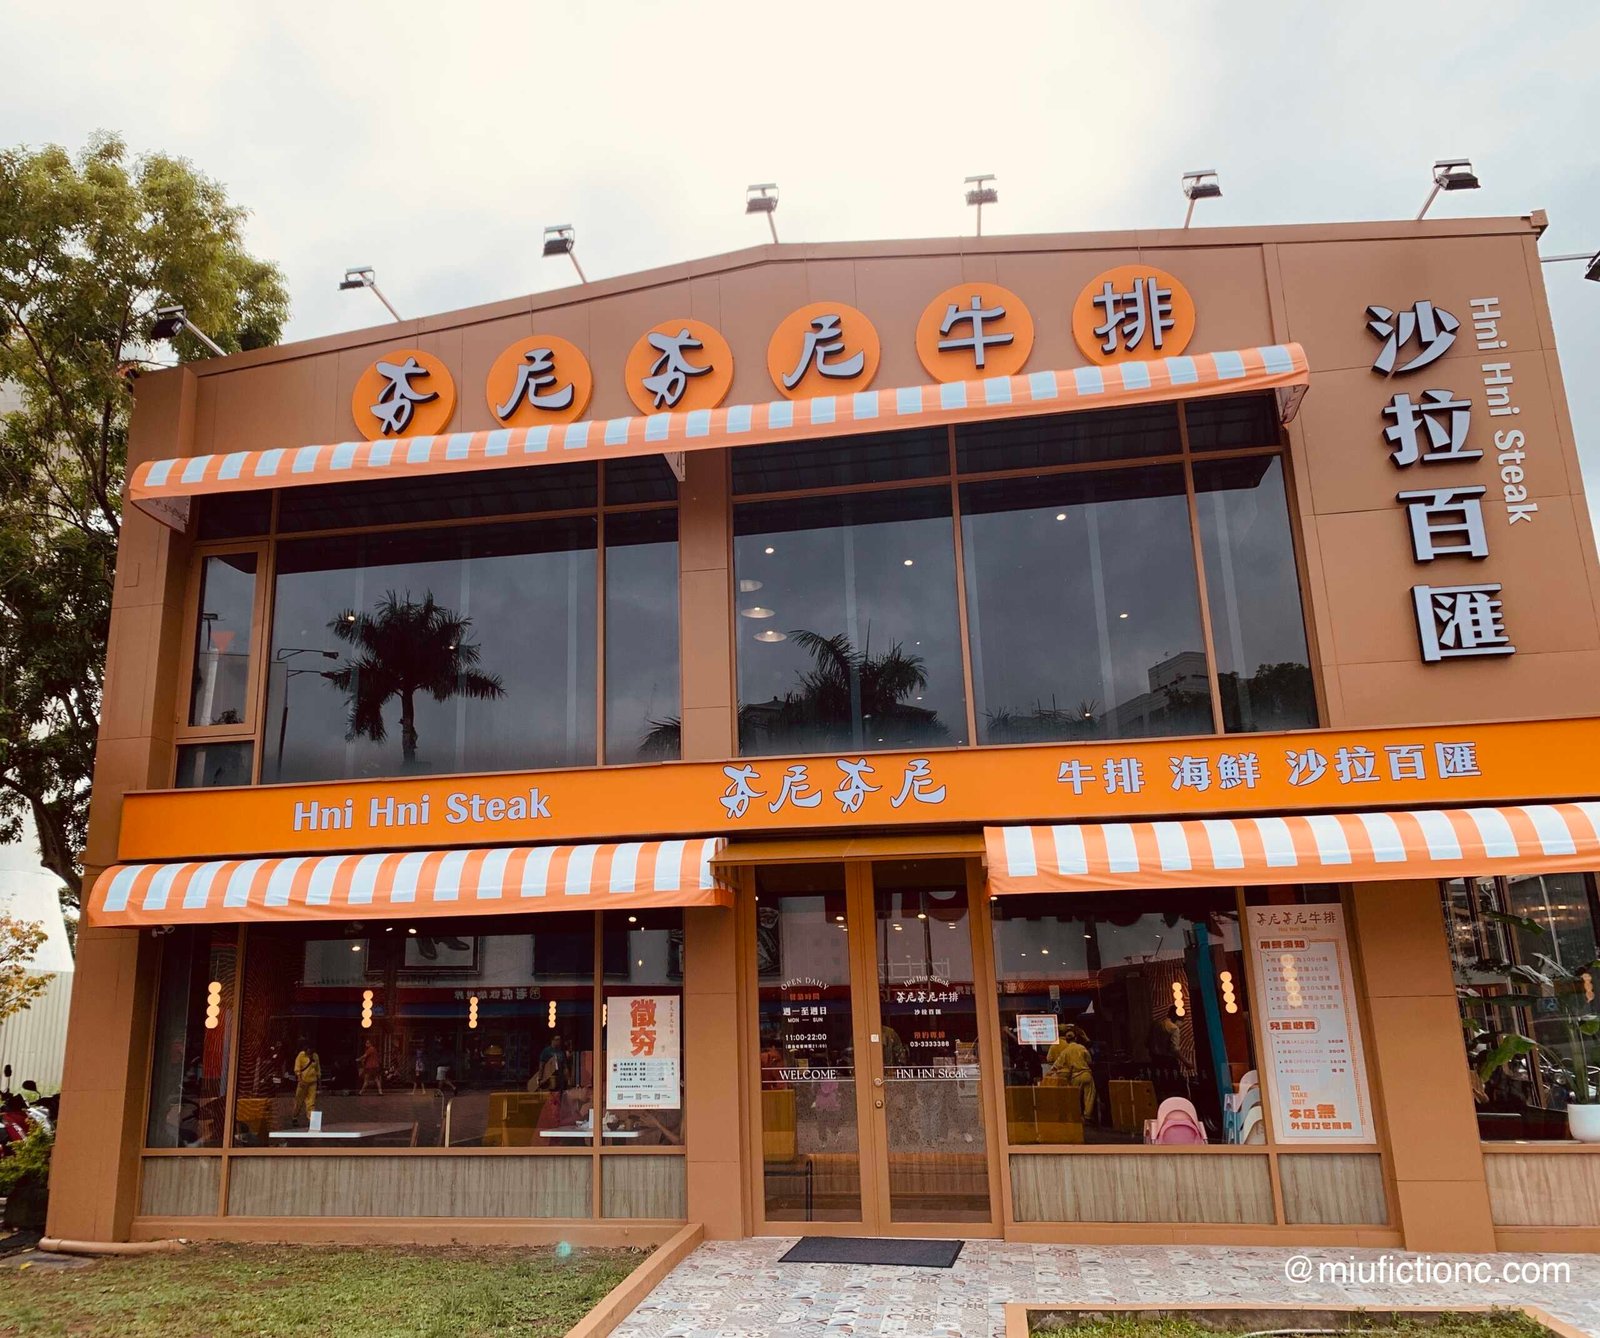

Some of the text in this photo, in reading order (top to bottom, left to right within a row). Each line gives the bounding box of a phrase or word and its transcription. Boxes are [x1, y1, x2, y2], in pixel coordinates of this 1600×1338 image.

[370, 277, 1175, 436] 夯尼夯尼牛排
[1470, 297, 1538, 525] Hni Hni Steak
[1365, 299, 1516, 662] 沙拉百匯
[719, 758, 946, 819] 夯尼夯尼
[1057, 741, 1482, 795] 牛排 海鮮 沙拉百匯
[293, 788, 552, 831] Hni Hni Steak
[781, 977, 830, 991] OPEN DAILY
[783, 1006, 827, 1016] 週一至週日
[785, 1033, 827, 1041] 11:00-22:00
[779, 1069, 837, 1080] WELCOME
[938, 1068, 968, 1079] Steak
